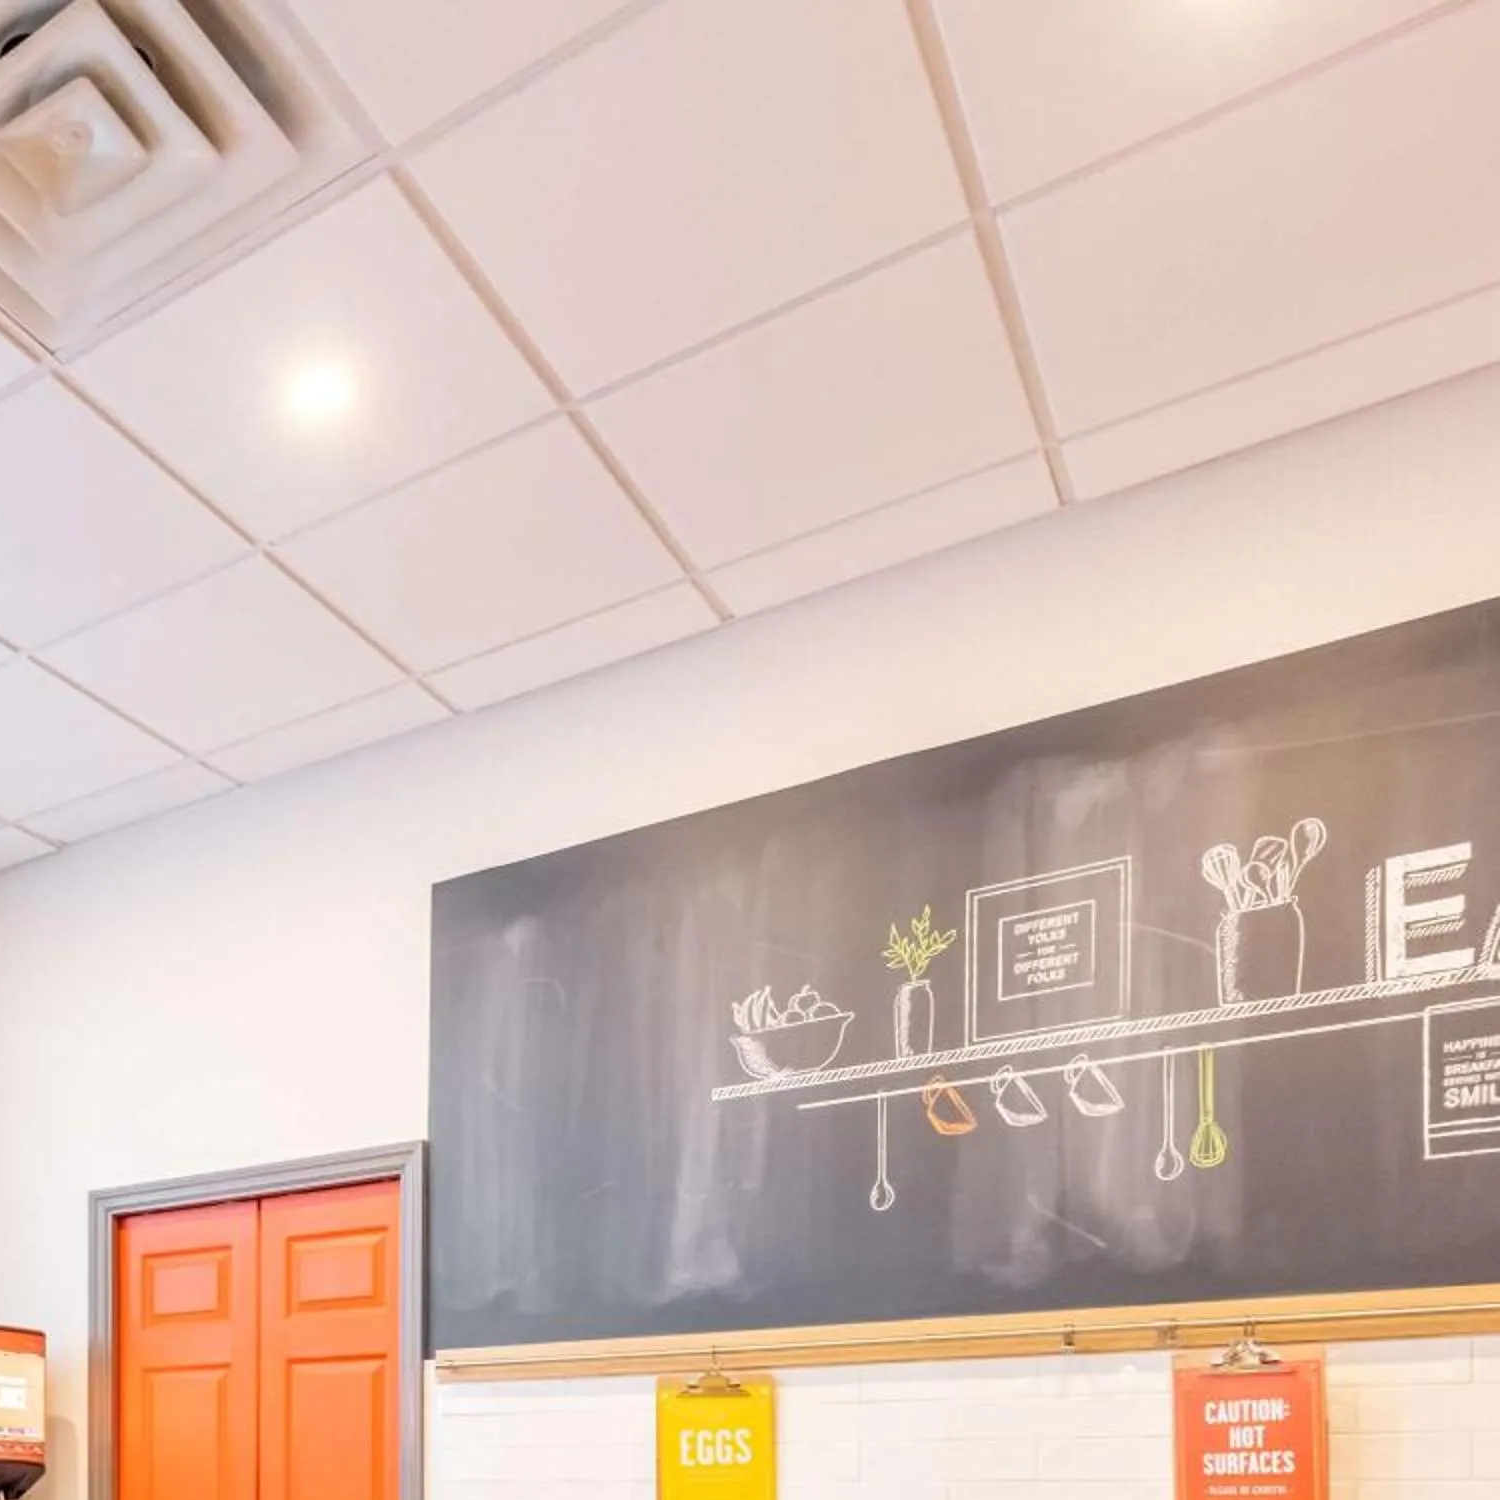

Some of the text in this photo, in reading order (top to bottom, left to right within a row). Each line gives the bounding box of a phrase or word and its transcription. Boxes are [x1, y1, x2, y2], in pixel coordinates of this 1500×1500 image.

[1365, 841, 1500, 980] E
[1013, 911, 1079, 936] DIFFERENT
[1027, 928, 1066, 945] YOLKS
[1013, 952, 1079, 976] DIFFERENT
[1027, 967, 1066, 985] FOLKS
[1204, 1397, 1292, 1425] CAUTION:
[678, 1428, 753, 1467] EGGS
[1228, 1425, 1266, 1449] HOT
[1202, 1450, 1296, 1476] SURFACES
